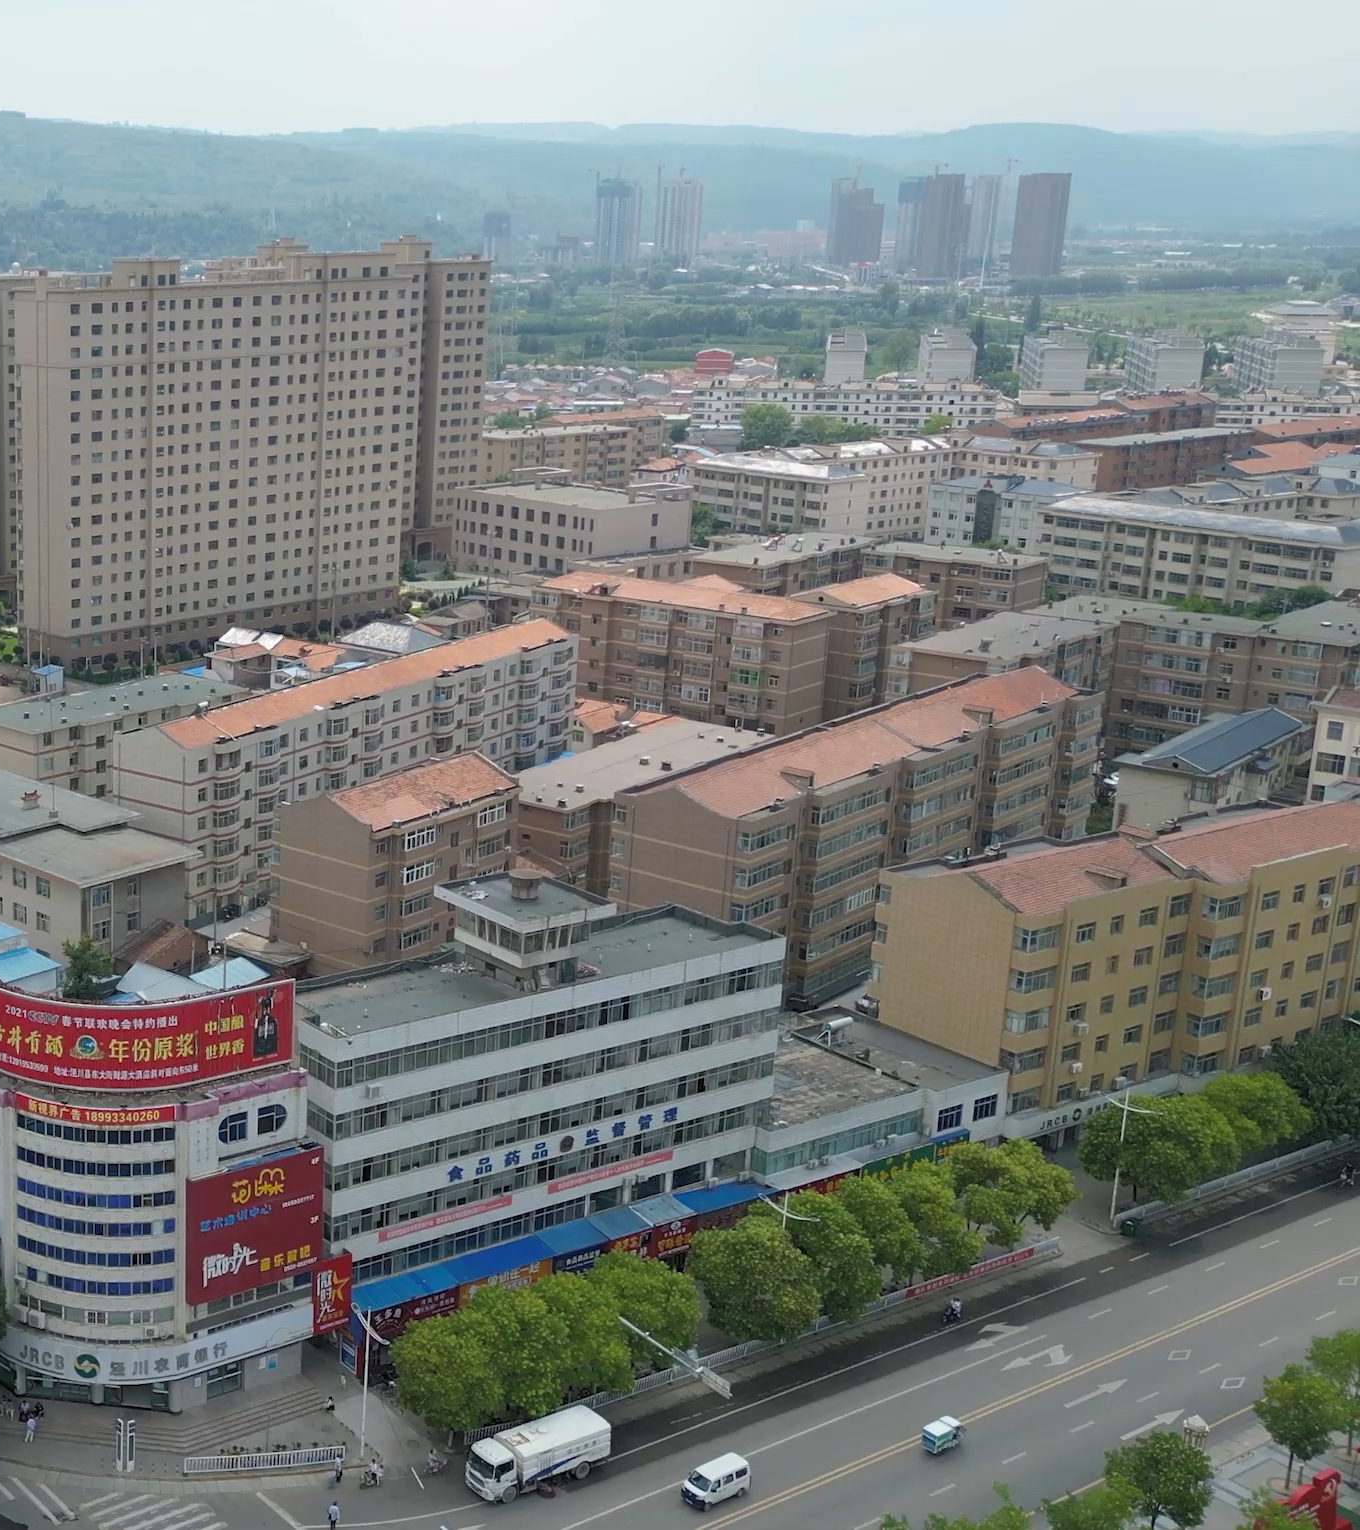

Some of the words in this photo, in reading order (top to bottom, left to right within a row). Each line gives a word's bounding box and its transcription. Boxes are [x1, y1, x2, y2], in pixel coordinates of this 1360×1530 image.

[108, 1032, 194, 1063] 年份原浆
[205, 1038, 245, 1060] 世界香
[28, 1099, 81, 1121] 新视界广告
[1040, 1115, 1068, 1130] JRCB
[311, 1156, 321, 1165] 4F
[310, 1215, 320, 1224] 3F
[202, 1242, 259, 1288] 微时光
[316, 1269, 336, 1324] 微时光
[20, 1345, 65, 1370] JRCB
[109, 1340, 228, 1377] 泾川农商银行
